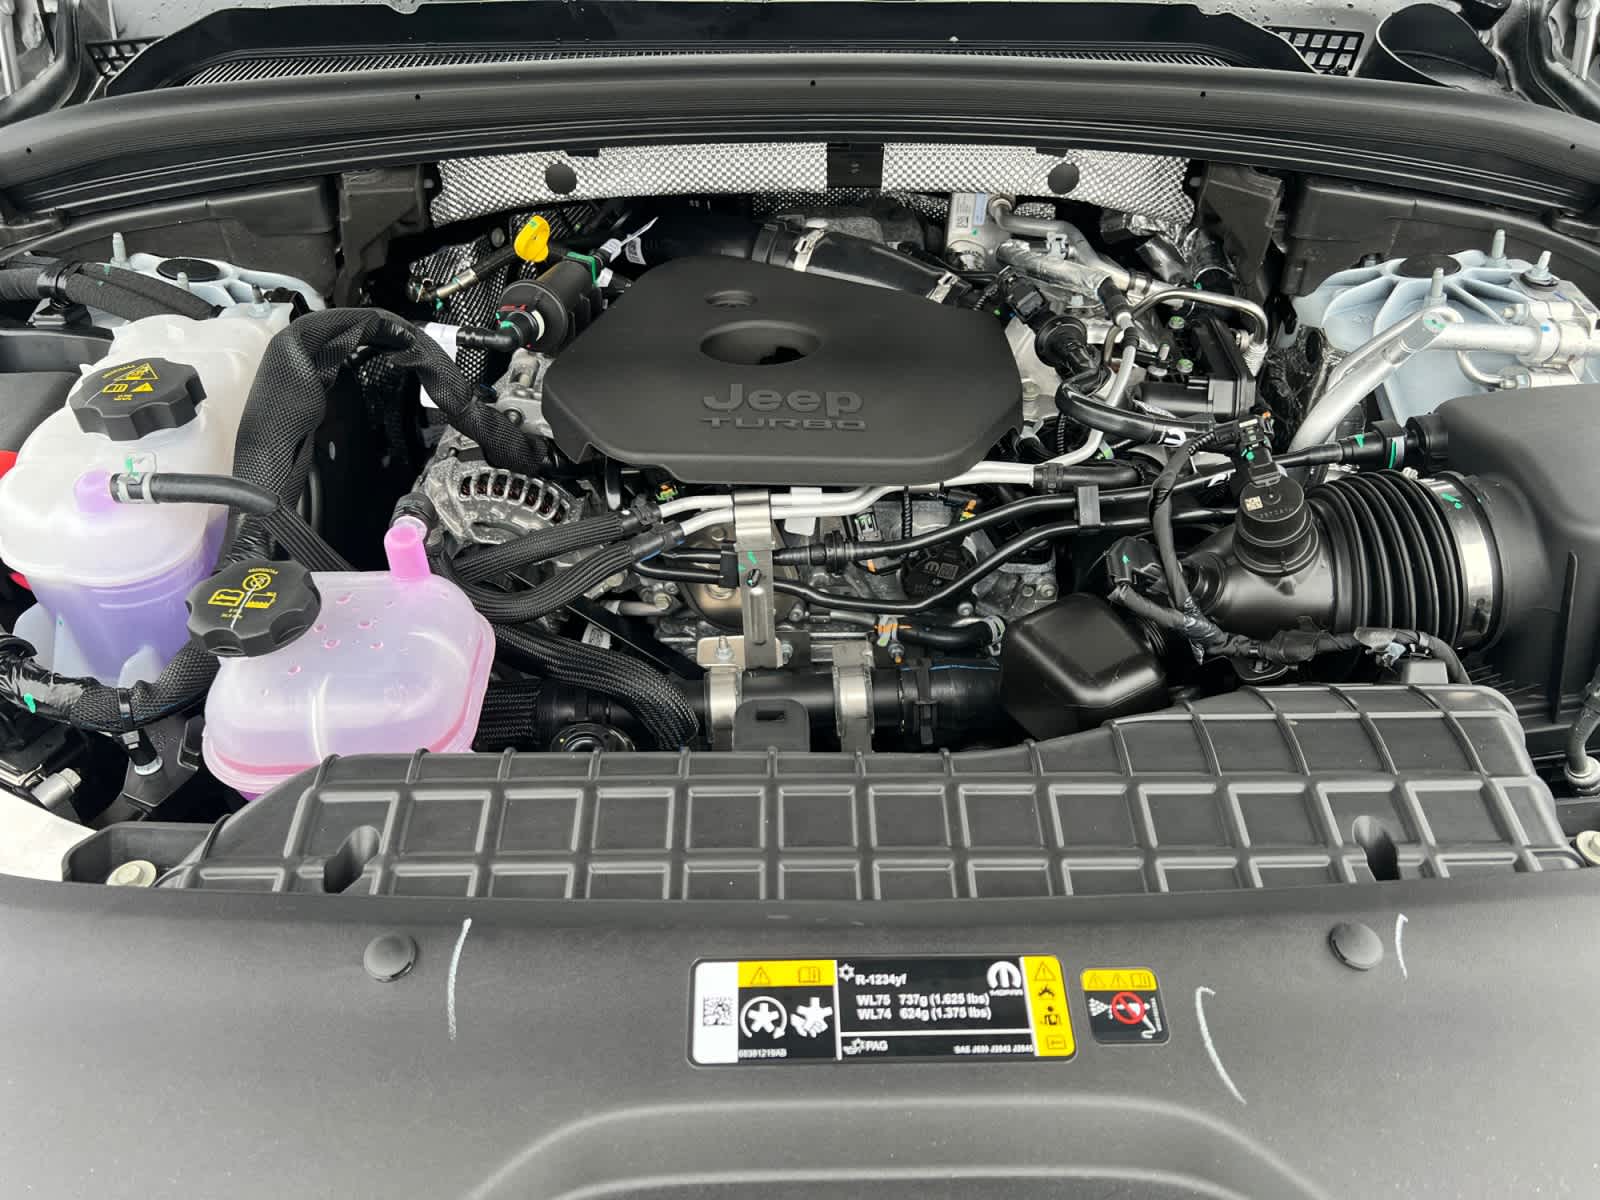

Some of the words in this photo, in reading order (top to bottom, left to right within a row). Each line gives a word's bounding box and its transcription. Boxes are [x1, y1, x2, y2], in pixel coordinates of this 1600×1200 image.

[703, 384, 863, 417] Jeep
[701, 417, 867, 431] TURBO
[855, 973, 907, 987] R-1234yf
[856, 994, 891, 1006] WL75
[898, 993, 928, 1007] 737g
[929, 992, 966, 1007] (1.625
[966, 992, 990, 1006] lbs)
[857, 1007, 892, 1020] WL74
[899, 1007, 930, 1021] 624g
[930, 1006, 967, 1021] (1.375
[968, 1006, 992, 1020] lbs)
[865, 1040, 889, 1052] PAG
